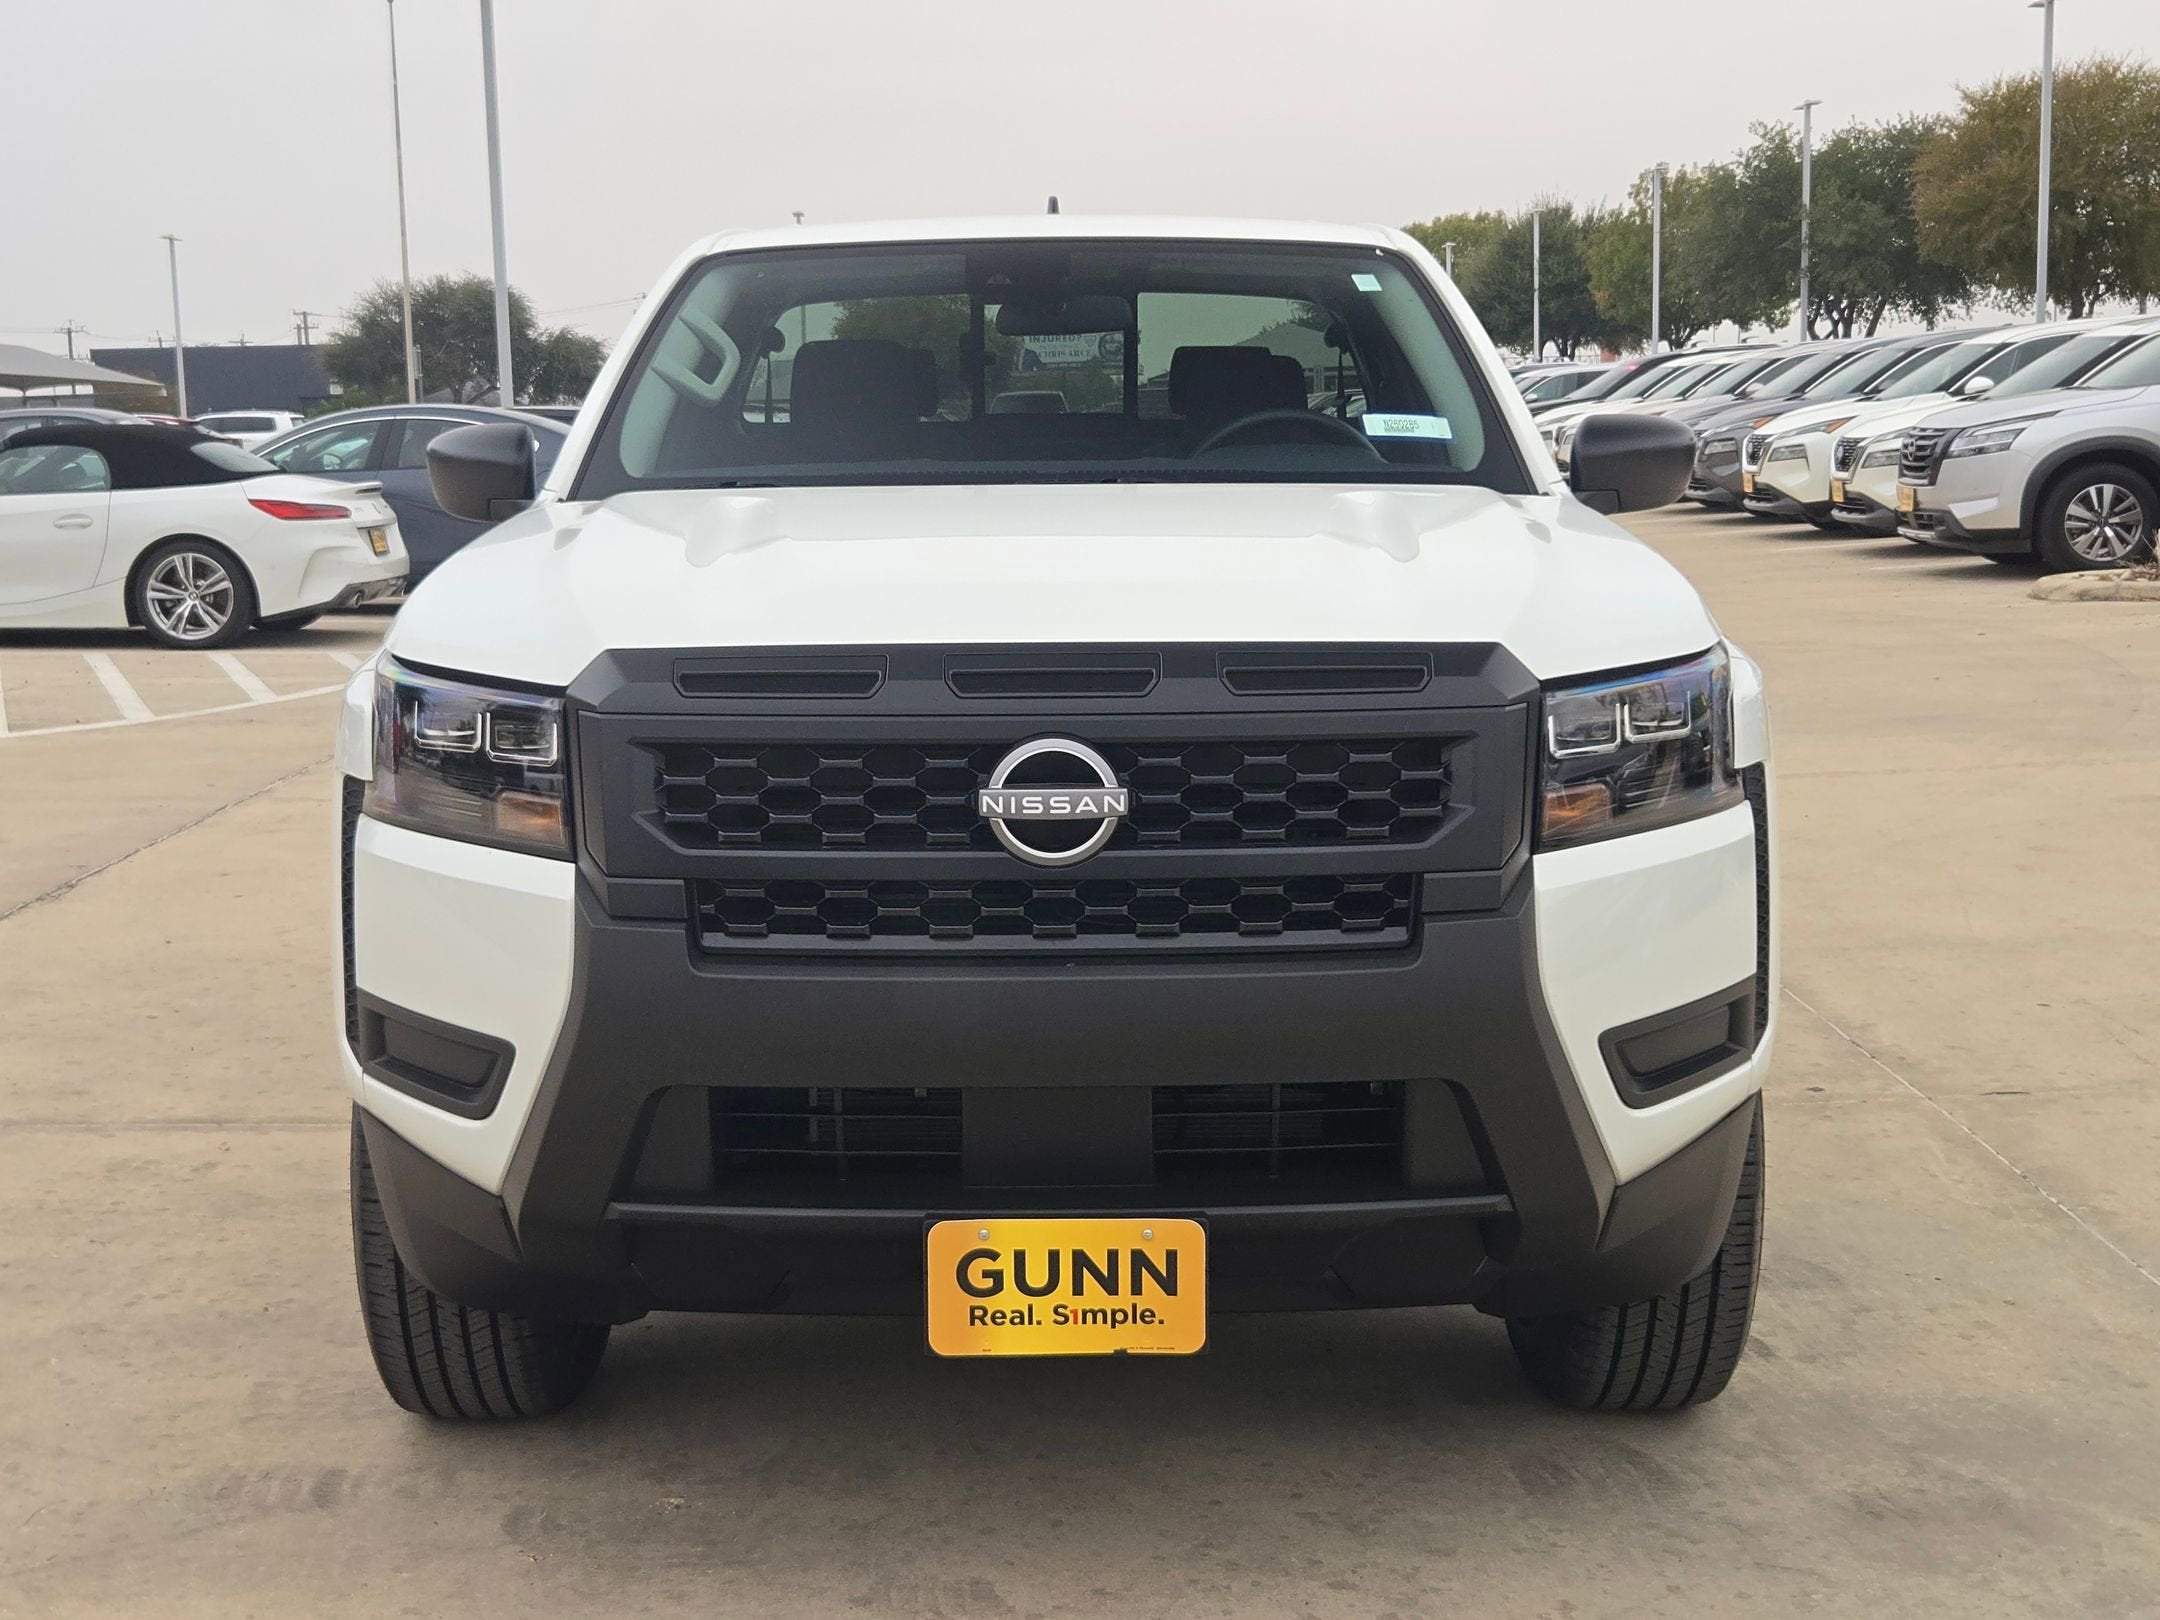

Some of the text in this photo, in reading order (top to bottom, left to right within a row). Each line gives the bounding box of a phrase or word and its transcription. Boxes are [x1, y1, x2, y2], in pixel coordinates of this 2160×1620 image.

[1029, 334, 1082, 343] INJURED?
[981, 795, 1125, 814] NISSAN
[955, 1248, 1179, 1298] GUNN
[968, 1303, 1043, 1327] Real.
